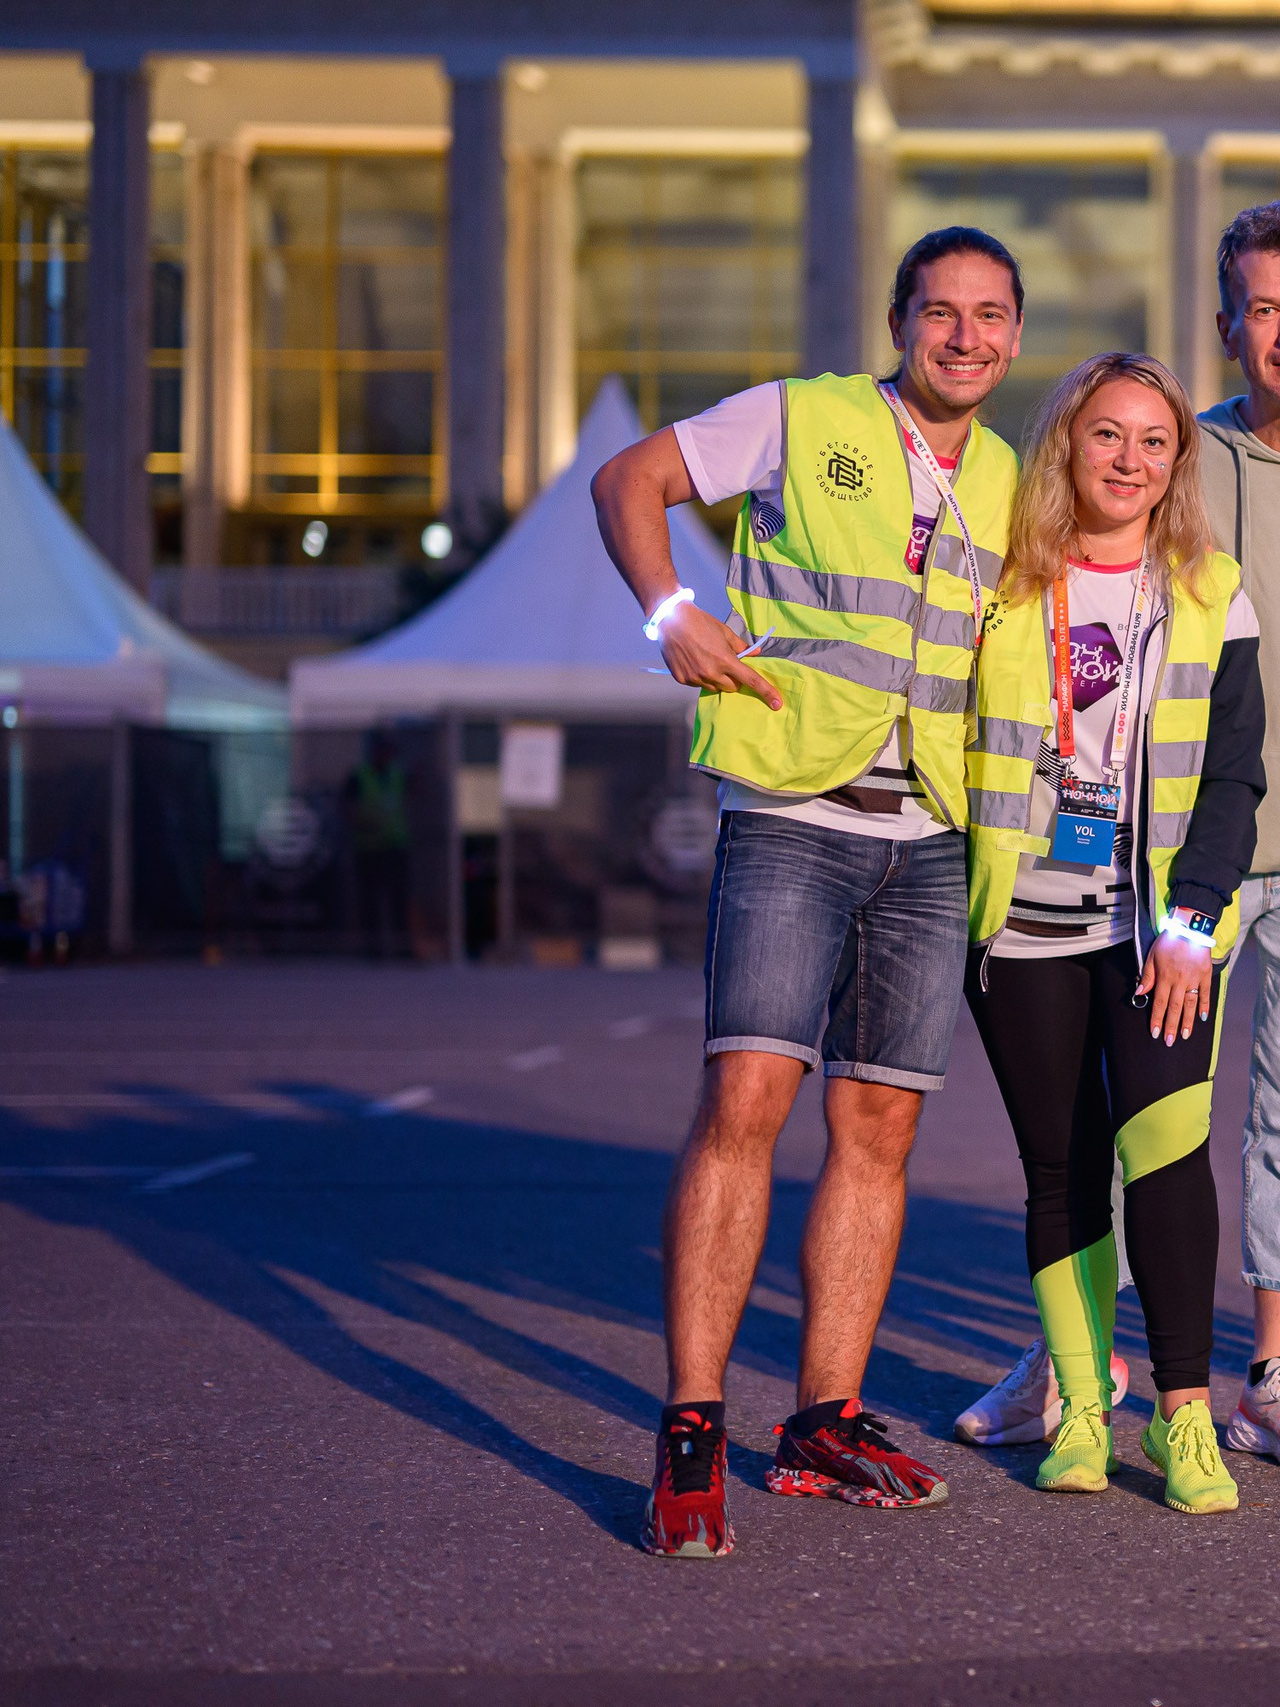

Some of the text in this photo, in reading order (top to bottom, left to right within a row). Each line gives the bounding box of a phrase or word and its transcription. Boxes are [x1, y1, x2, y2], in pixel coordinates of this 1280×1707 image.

[895, 404, 912, 430] МОСКВА
[910, 431, 917, 440] 10
[915, 440, 927, 453] ЛЕТ
[819, 442, 873, 469] БЕГОВОЕ
[816, 474, 872, 501] СООБЩЕСТВО
[947, 494, 958, 512] БЫТЬ
[1059, 635, 1066, 643] 10
[1121, 612, 1142, 711] БЫТЬ ПРИМЕРОМ ДЛЯ МНОГИХ
[1078, 783, 1103, 791] 2024
[1075, 824, 1096, 837] VOL
